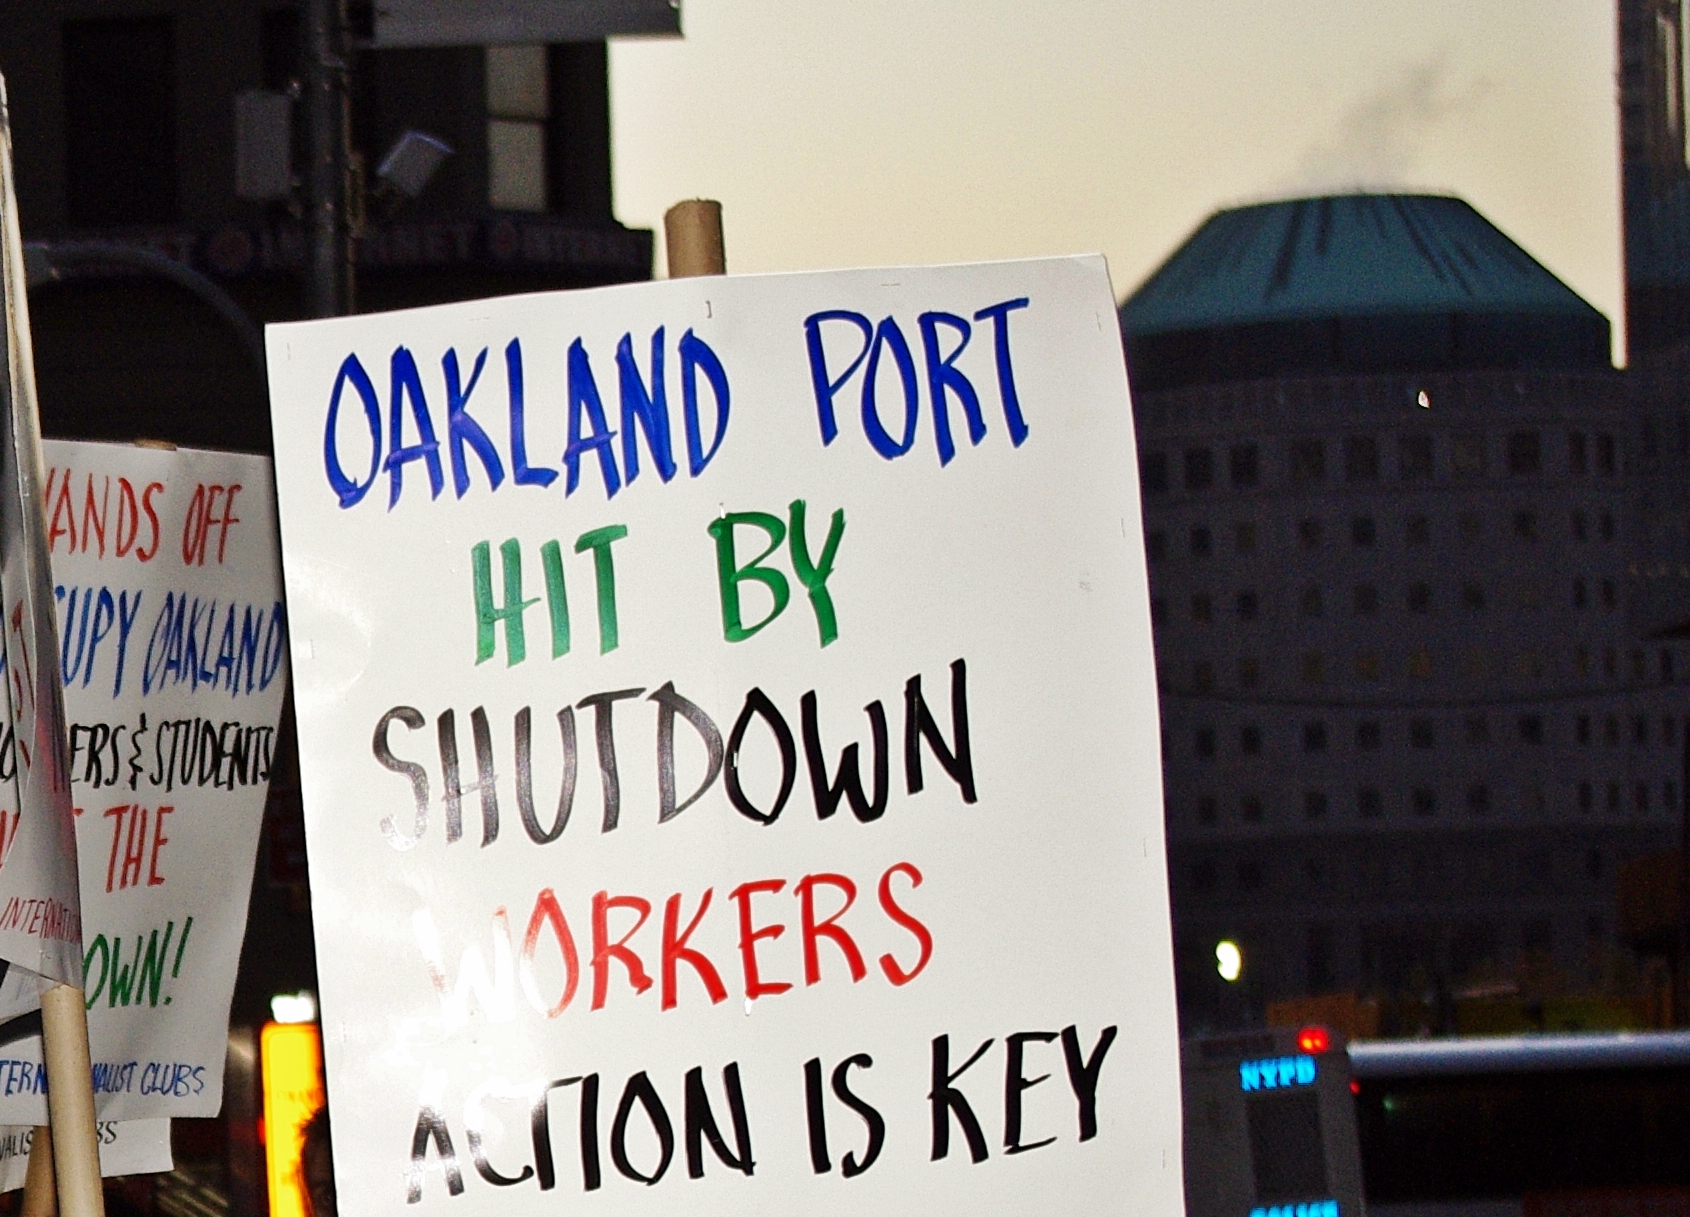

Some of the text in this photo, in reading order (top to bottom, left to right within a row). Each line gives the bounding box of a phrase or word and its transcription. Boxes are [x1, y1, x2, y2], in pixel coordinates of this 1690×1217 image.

[323, 296, 1030, 512] OAKLAND PORT
[182, 483, 243, 567] OFF
[473, 497, 846, 668] HIT BY
[142, 590, 287, 699] OAKLAND
[149, 718, 276, 793] STUDENTS
[372, 657, 978, 852] SHUTDOWN
[103, 805, 174, 894] THE
[410, 861, 935, 1021] WORKERS
[140, 1061, 207, 1098] CLUBS
[406, 1024, 1119, 1205] ACTION IS KEY
[1239, 1055, 1318, 1092] NYPD
